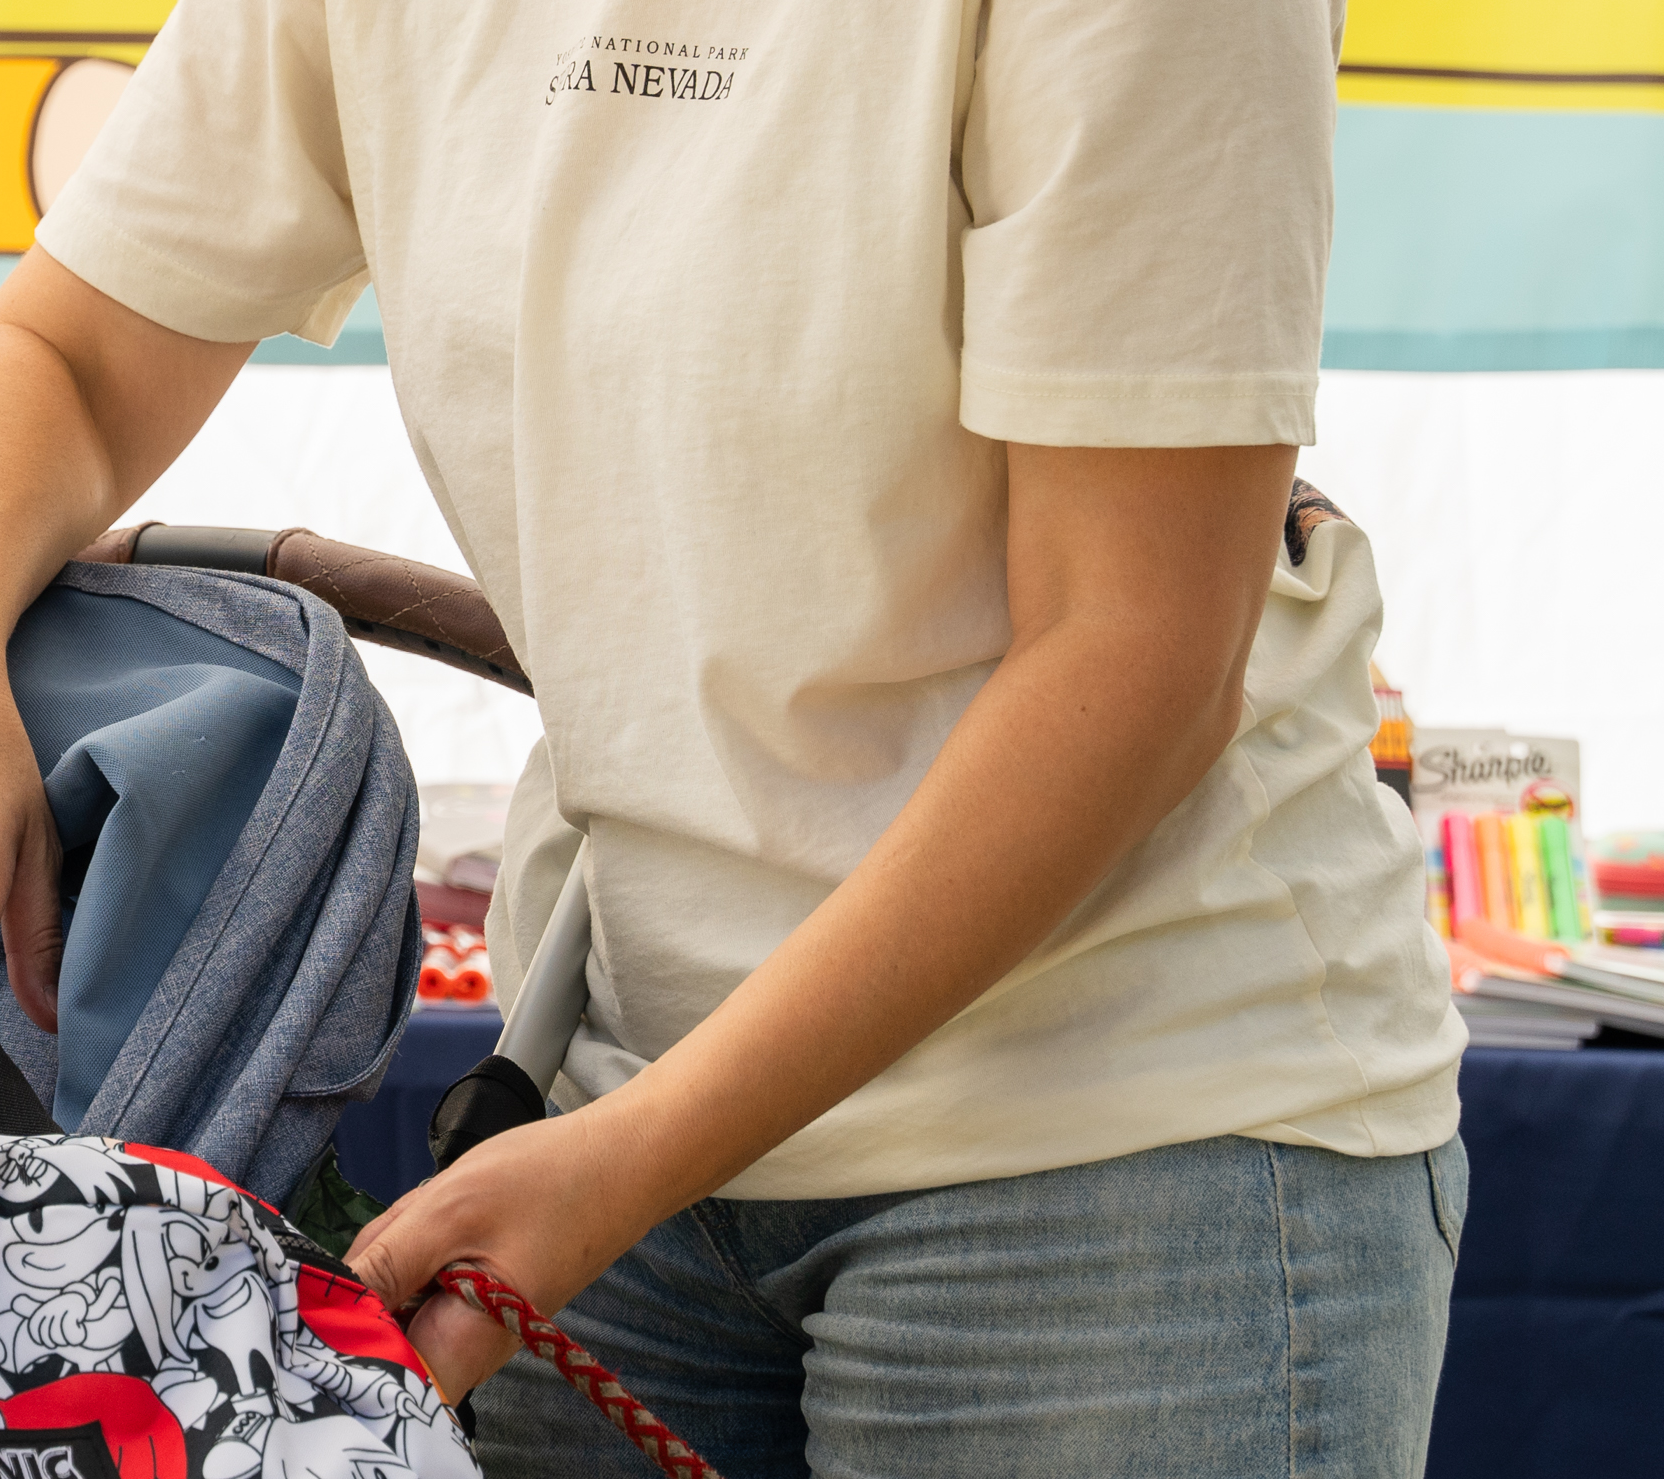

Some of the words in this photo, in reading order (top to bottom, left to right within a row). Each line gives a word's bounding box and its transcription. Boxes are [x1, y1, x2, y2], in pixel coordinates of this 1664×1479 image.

[590, 35, 702, 59] NATIONAL
[707, 46, 751, 61] PARK
[611, 62, 735, 101] NEVADA
[1410, 745, 1548, 793] Sharpie
